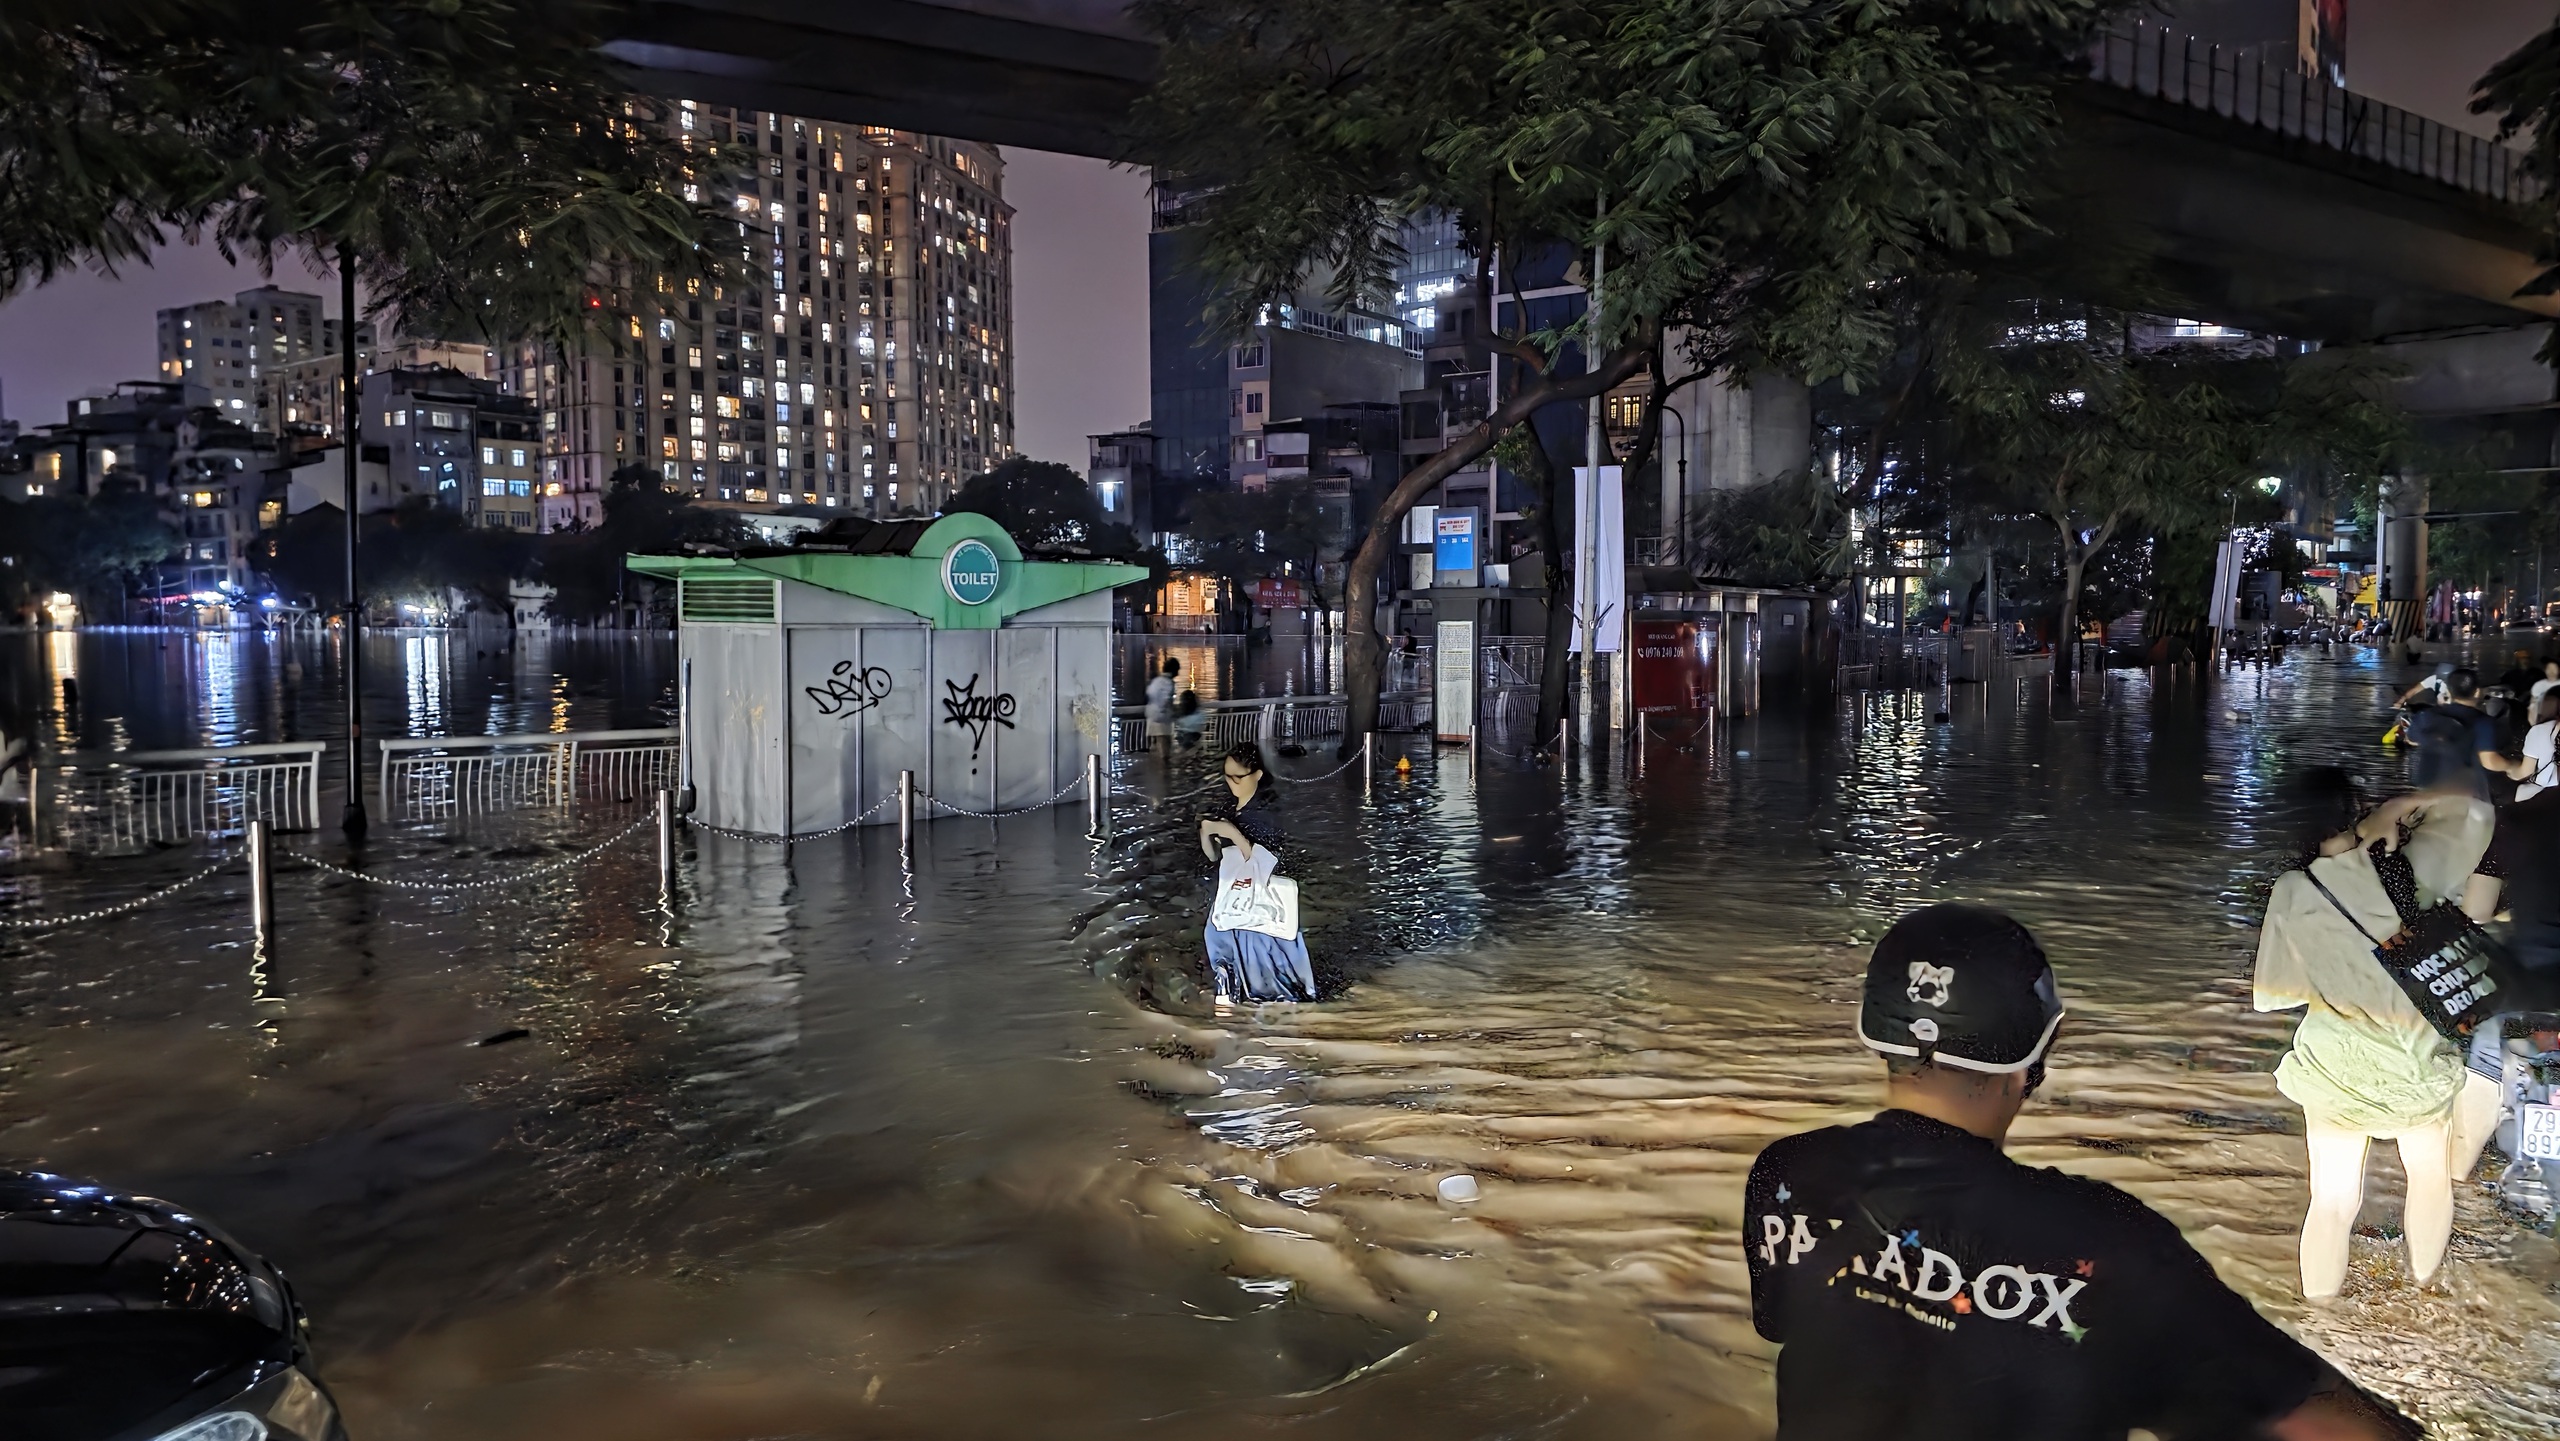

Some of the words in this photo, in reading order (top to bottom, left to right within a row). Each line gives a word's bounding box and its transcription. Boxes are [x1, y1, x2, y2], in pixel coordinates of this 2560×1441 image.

[952, 573, 996, 585] TOILET
[1645, 647, 1661, 658] 0976
[1661, 647, 1673, 658] 240
